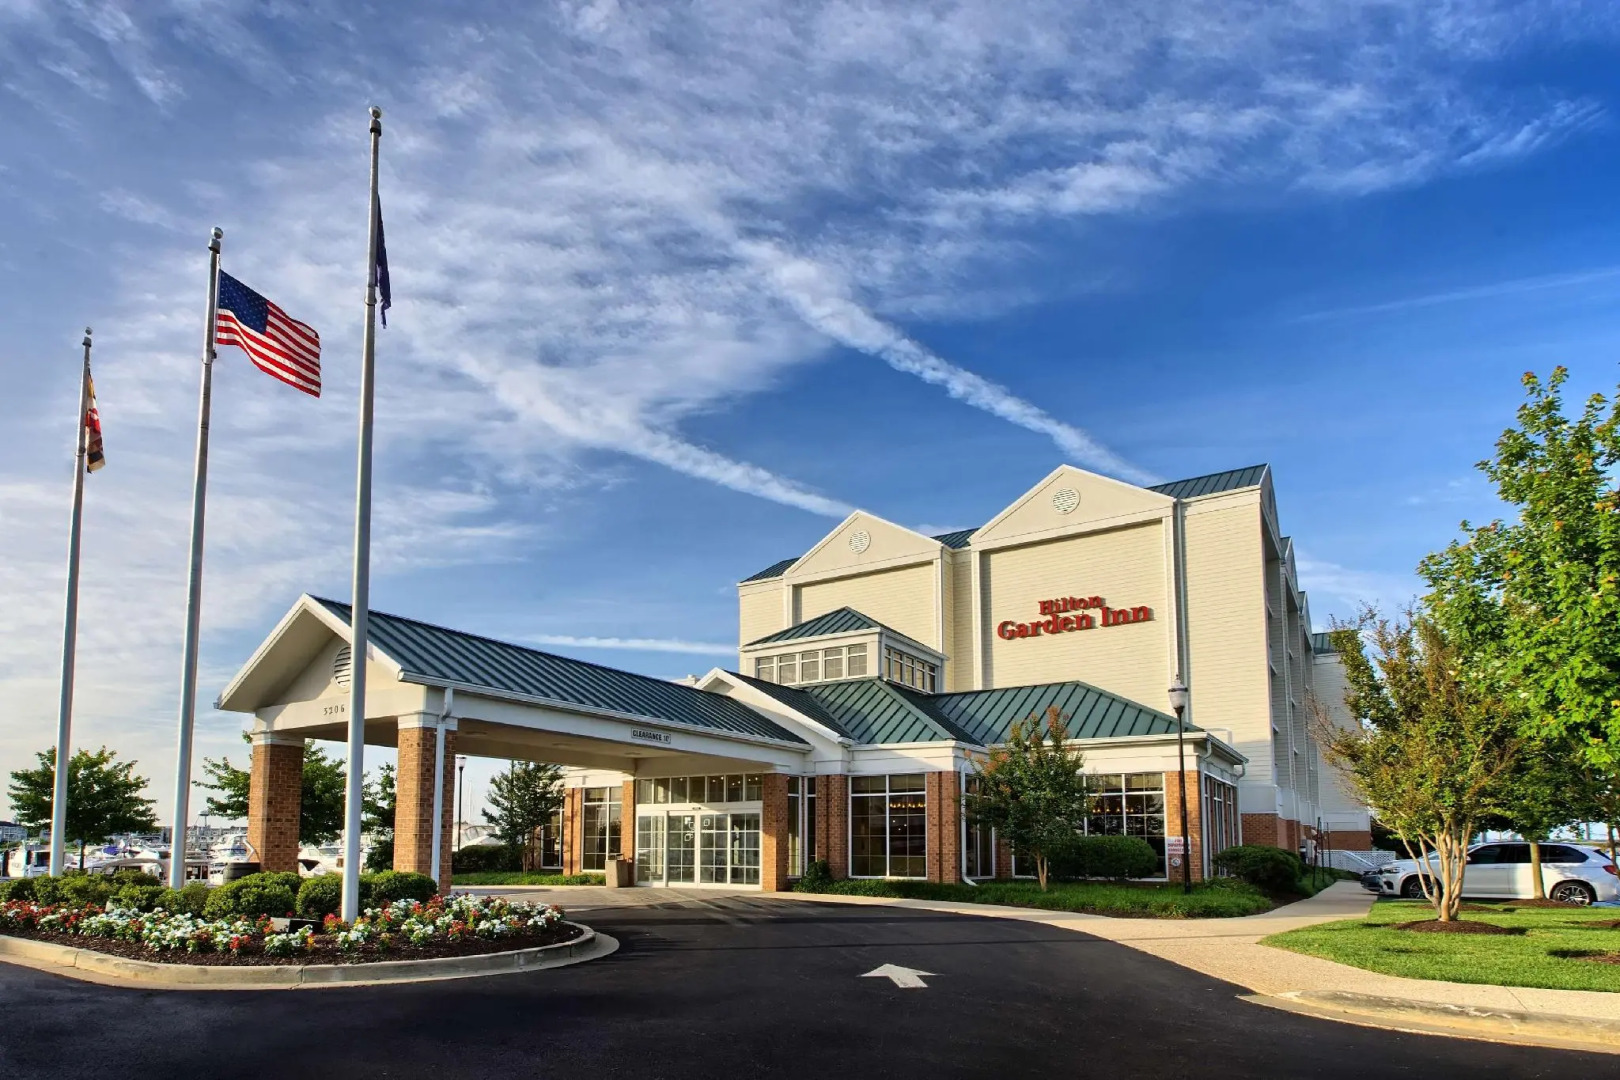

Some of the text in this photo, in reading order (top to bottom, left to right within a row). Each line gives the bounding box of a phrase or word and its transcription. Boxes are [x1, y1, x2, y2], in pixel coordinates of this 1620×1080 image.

[1038, 595, 1104, 615] Hilton
[997, 605, 1153, 640] Garden Inn
[632, 729, 662, 741] CLEARANCE
